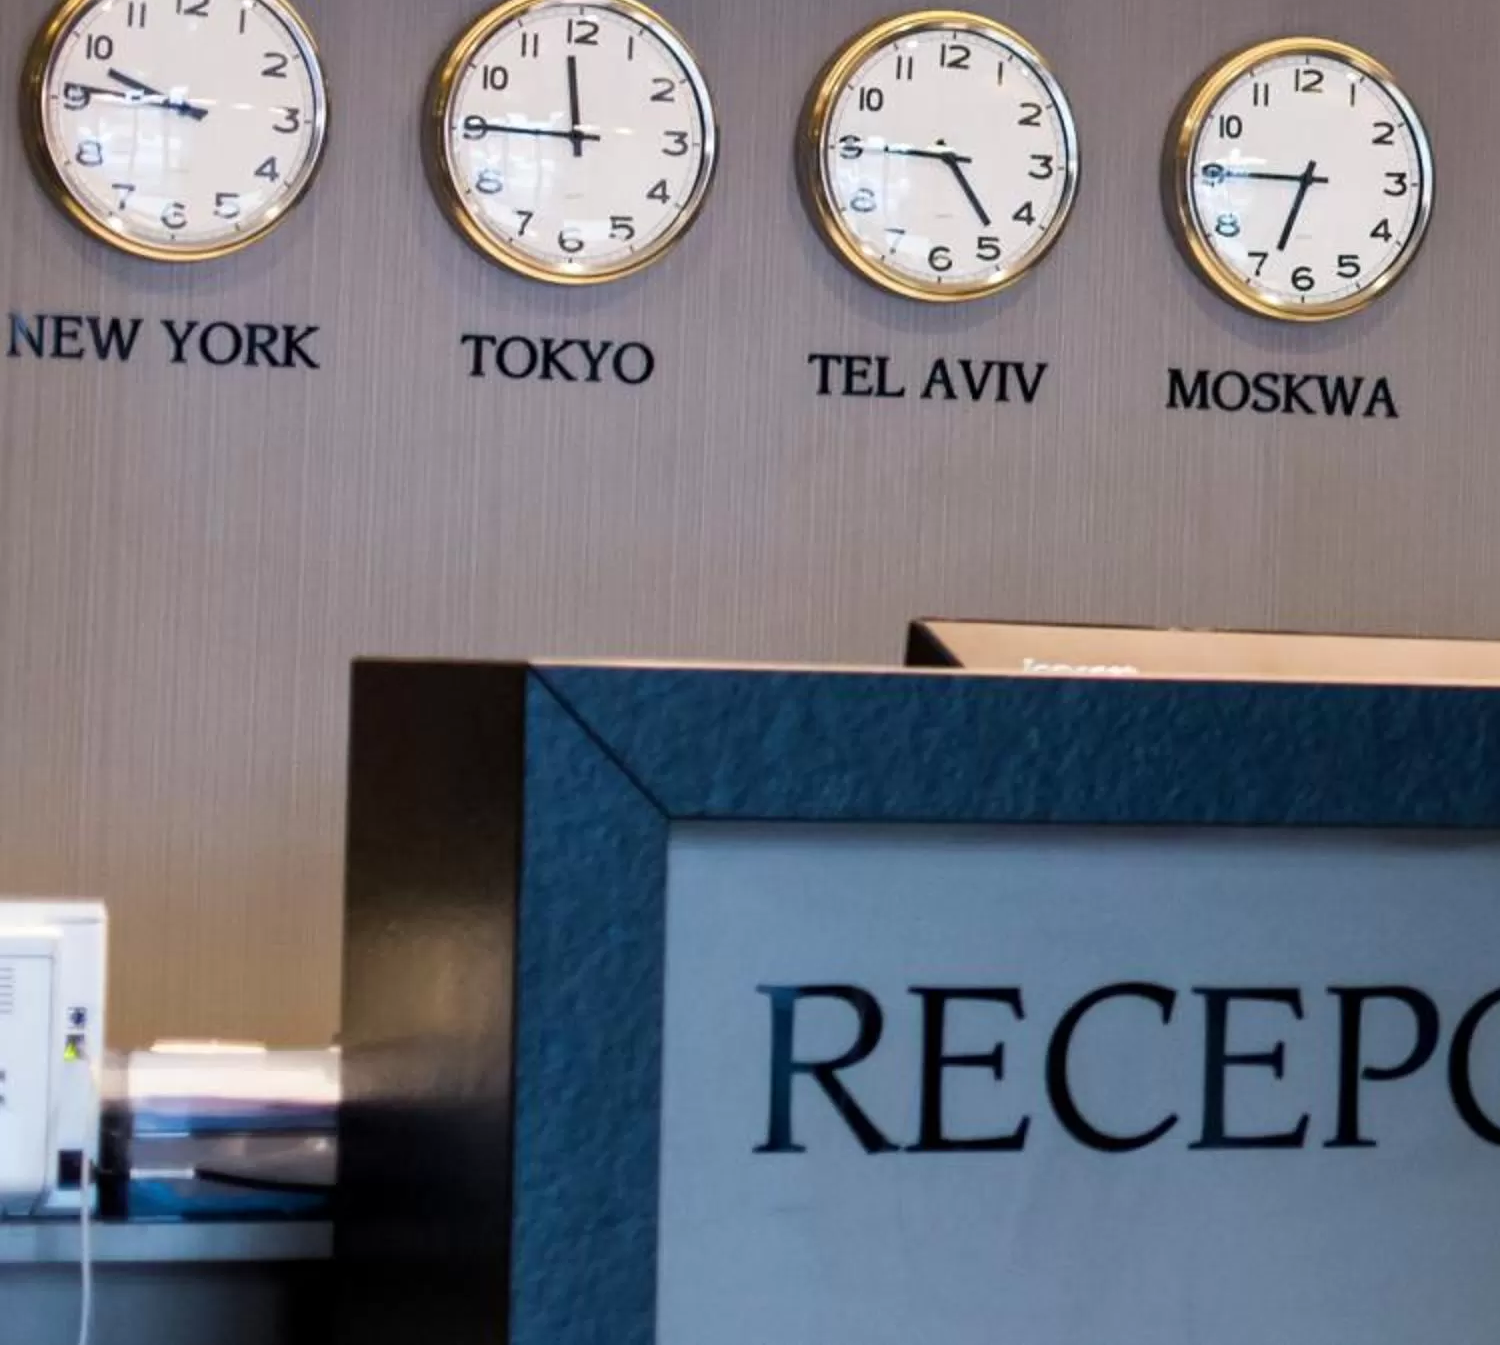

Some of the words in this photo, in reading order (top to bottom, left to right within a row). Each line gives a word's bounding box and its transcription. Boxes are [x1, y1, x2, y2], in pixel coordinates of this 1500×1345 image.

[127, 1, 147, 28] 11
[238, 8, 247, 34] 1
[566, 18, 599, 46] 12
[86, 33, 113, 60] 10
[521, 32, 539, 58] 11
[627, 35, 634, 60] 1
[940, 43, 971, 70] 12
[261, 53, 288, 78] 2
[483, 64, 508, 90] 10
[896, 56, 913, 81] 11
[997, 61, 1003, 86] 1
[650, 78, 675, 102] 2
[1295, 68, 1324, 92] 12
[859, 86, 884, 112] 10
[1253, 83, 1269, 107] 11
[1350, 83, 1356, 107] 1
[272, 108, 300, 133] 3
[1018, 102, 1042, 127] 2
[1219, 115, 1243, 139] 10
[661, 131, 688, 157] 3
[1372, 122, 1395, 145] 2
[75, 140, 103, 167] 8
[254, 156, 280, 182] 4
[1028, 154, 1053, 180] 3
[475, 169, 503, 194] 8
[646, 179, 671, 204] 4
[1383, 172, 1407, 196] 3
[112, 183, 136, 209] 7
[214, 192, 240, 219] 5
[850, 188, 877, 213] 8
[161, 202, 187, 229] 6
[516, 210, 533, 236] 7
[1012, 201, 1035, 226] 4
[1215, 213, 1240, 238] 8
[557, 227, 584, 253] 6
[609, 215, 635, 241] 5
[1370, 218, 1393, 242] 4
[928, 246, 953, 272] 6
[976, 236, 1001, 261] 5
[1247, 251, 1268, 276] 7
[1337, 254, 1361, 278] 5
[1291, 266, 1315, 291] 6
[8, 312, 144, 362] NEW
[160, 319, 320, 369] YORK
[460, 333, 655, 385] TOKYO
[807, 353, 905, 398] TEL
[919, 357, 1049, 403] AVIV
[1165, 368, 1399, 418] MOSKWA
